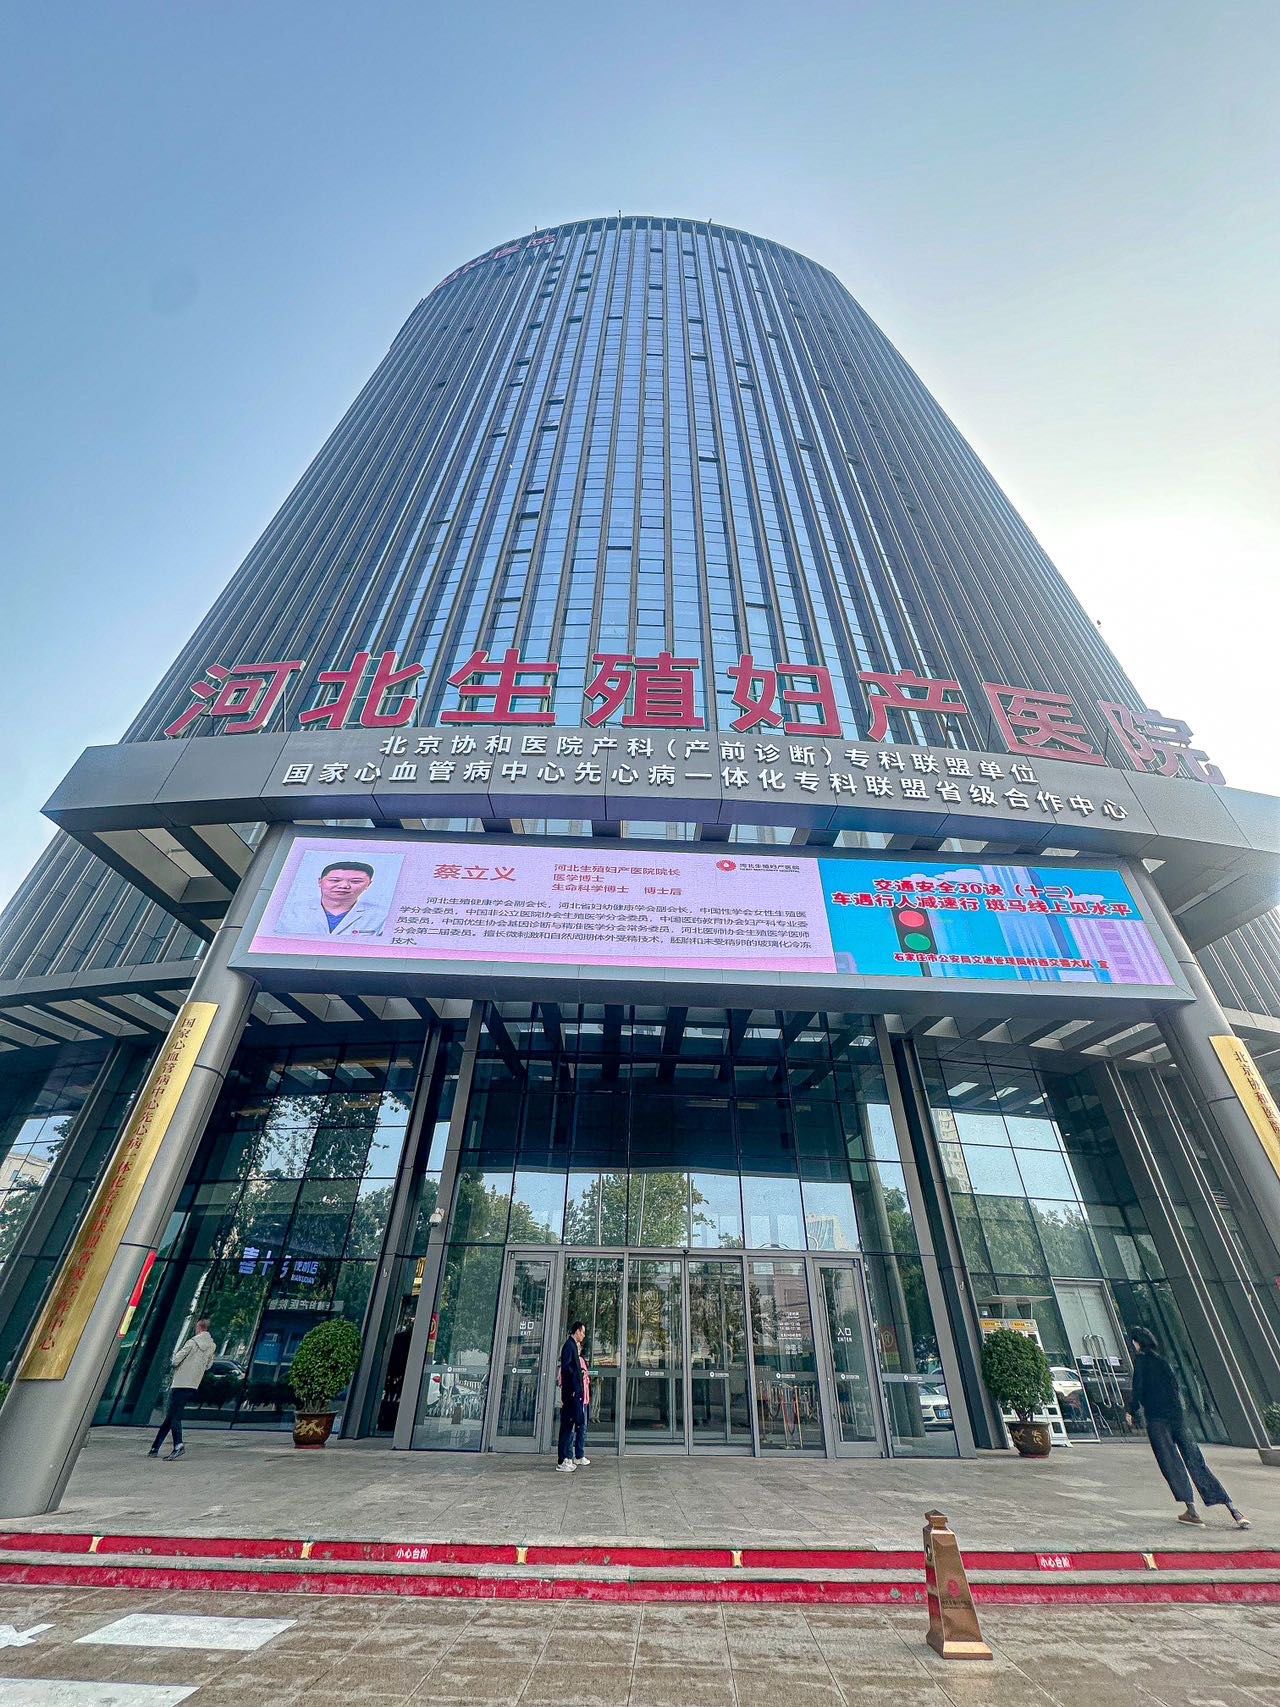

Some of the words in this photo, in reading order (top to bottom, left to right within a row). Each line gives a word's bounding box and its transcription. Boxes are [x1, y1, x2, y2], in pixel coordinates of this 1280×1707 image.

[164, 648, 1226, 785] 河北生殖妇产医院
[282, 761, 1129, 821] 国家心血管病中心先心病一体化专科联盟省级合作中心
[433, 864, 516, 881] 蔡立义
[554, 864, 681, 876] 河北生殖妇产医院院长
[553, 873, 605, 882] 医学博士
[551, 883, 629, 893] 生命科学博士
[644, 886, 682, 895] 博士后
[832, 891, 980, 911] 车遇行人减速行
[984, 898, 1132, 916] 斑马线上见水平
[38, 1017, 196, 1351] 国家心血管病中心先心病一体化专科联盟省级合作中心
[519, 1320, 535, 1330] 出口
[837, 1327, 852, 1336] 入口
[396, 1547, 429, 1560] 小心台阶
